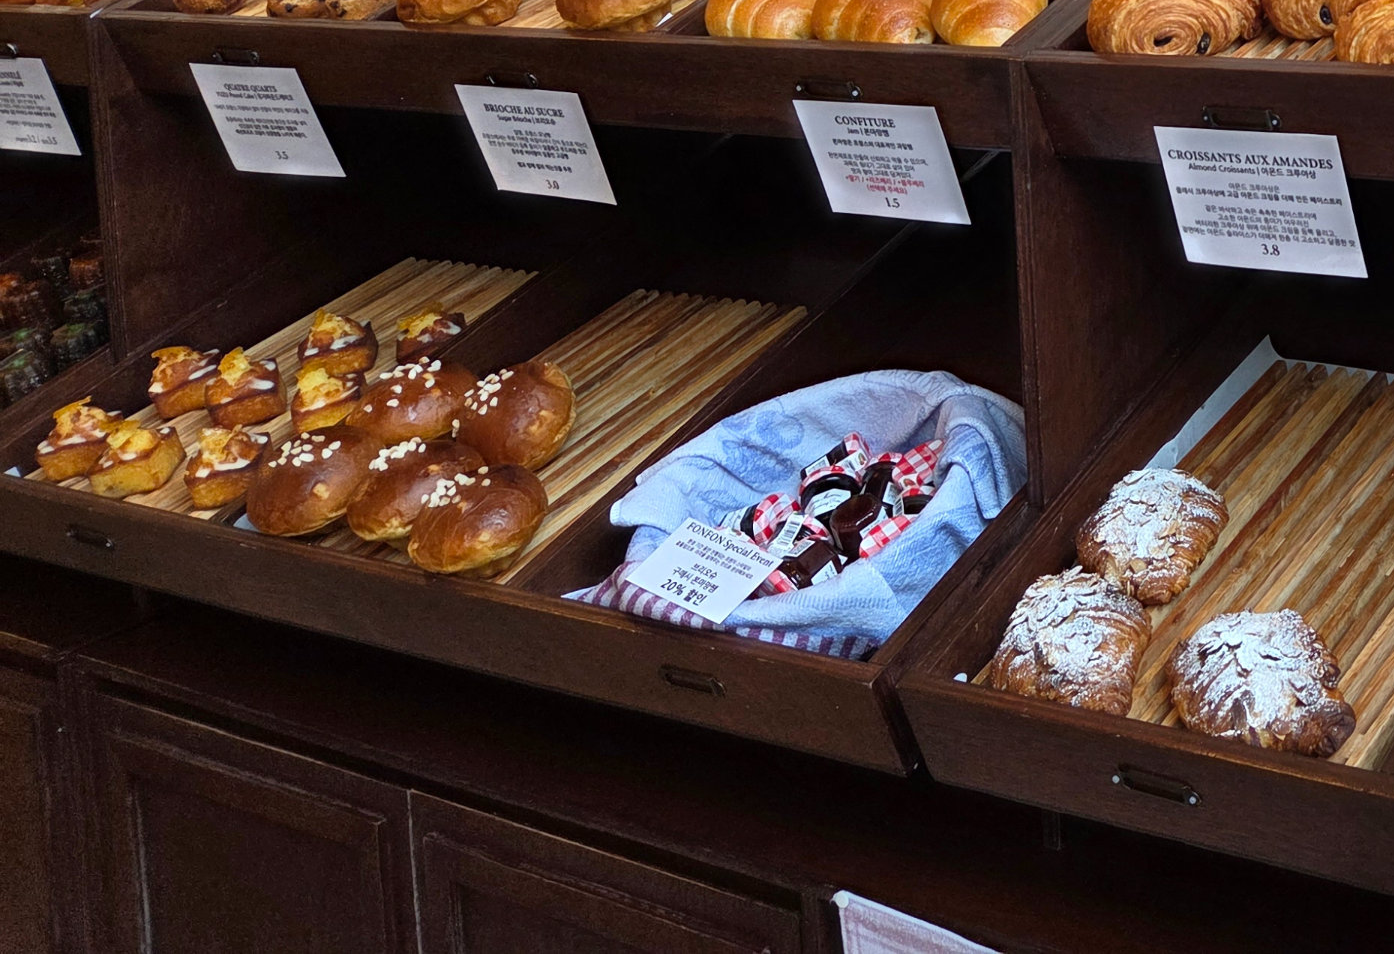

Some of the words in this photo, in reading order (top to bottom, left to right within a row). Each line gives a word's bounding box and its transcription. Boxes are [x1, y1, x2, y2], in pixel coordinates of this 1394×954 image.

[482, 103, 524, 115] BRIOCHE
[523, 106, 536, 116] AU
[535, 107, 565, 118] SUCRE
[834, 115, 896, 128] CONFITURE
[1167, 149, 1242, 164] CROISSANTS
[1244, 154, 1271, 166] AUX
[1271, 155, 1334, 170] AMANDES
[1188, 162, 1218, 172] Almond
[1217, 164, 1256, 175] Croissants
[545, 179, 560, 190] 3.0
[884, 196, 901, 209] 1.5
[1260, 243, 1281, 257] 3.8
[686, 521, 727, 545] FONFON
[722, 539, 754, 558] Special
[749, 551, 775, 568] Event
[690, 563, 718, 580] 브리오슈
[660, 578, 687, 596] 20%
[683, 588, 708, 607] 할인
